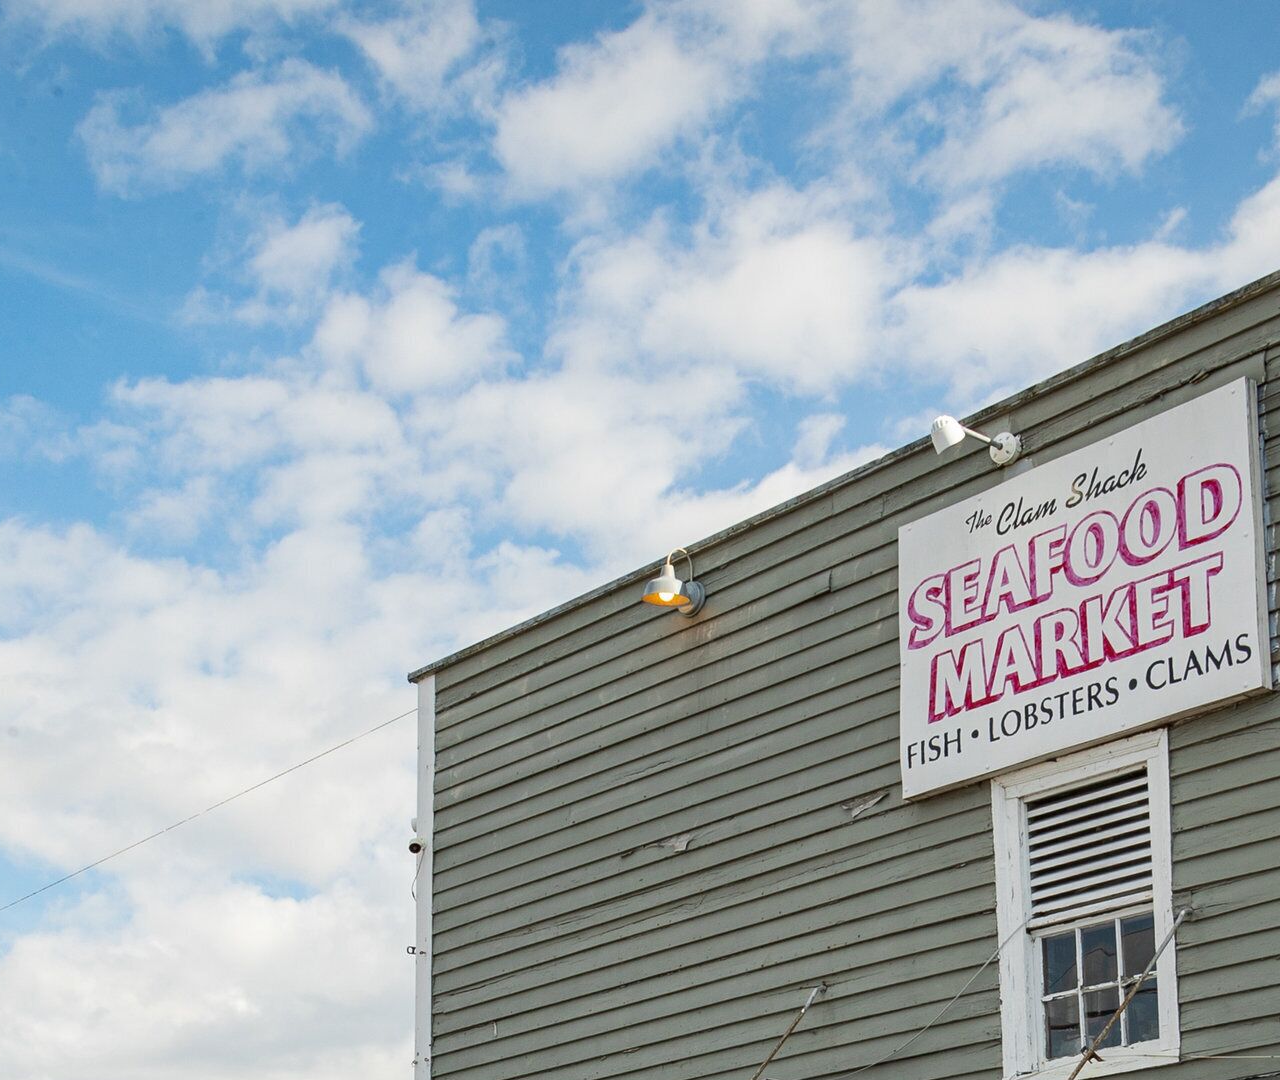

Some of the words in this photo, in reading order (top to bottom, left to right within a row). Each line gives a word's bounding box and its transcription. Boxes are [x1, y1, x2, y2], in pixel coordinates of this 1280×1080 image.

[907, 463, 1242, 650] SEAFOOD
[965, 510, 994, 535] The
[996, 496, 1058, 536] Clam
[1065, 448, 1148, 509] Shack
[907, 728, 963, 769] FISH
[989, 676, 1120, 743] LOBSTERS
[1145, 633, 1253, 691] CLAMS
[927, 551, 1224, 724] MARKET
